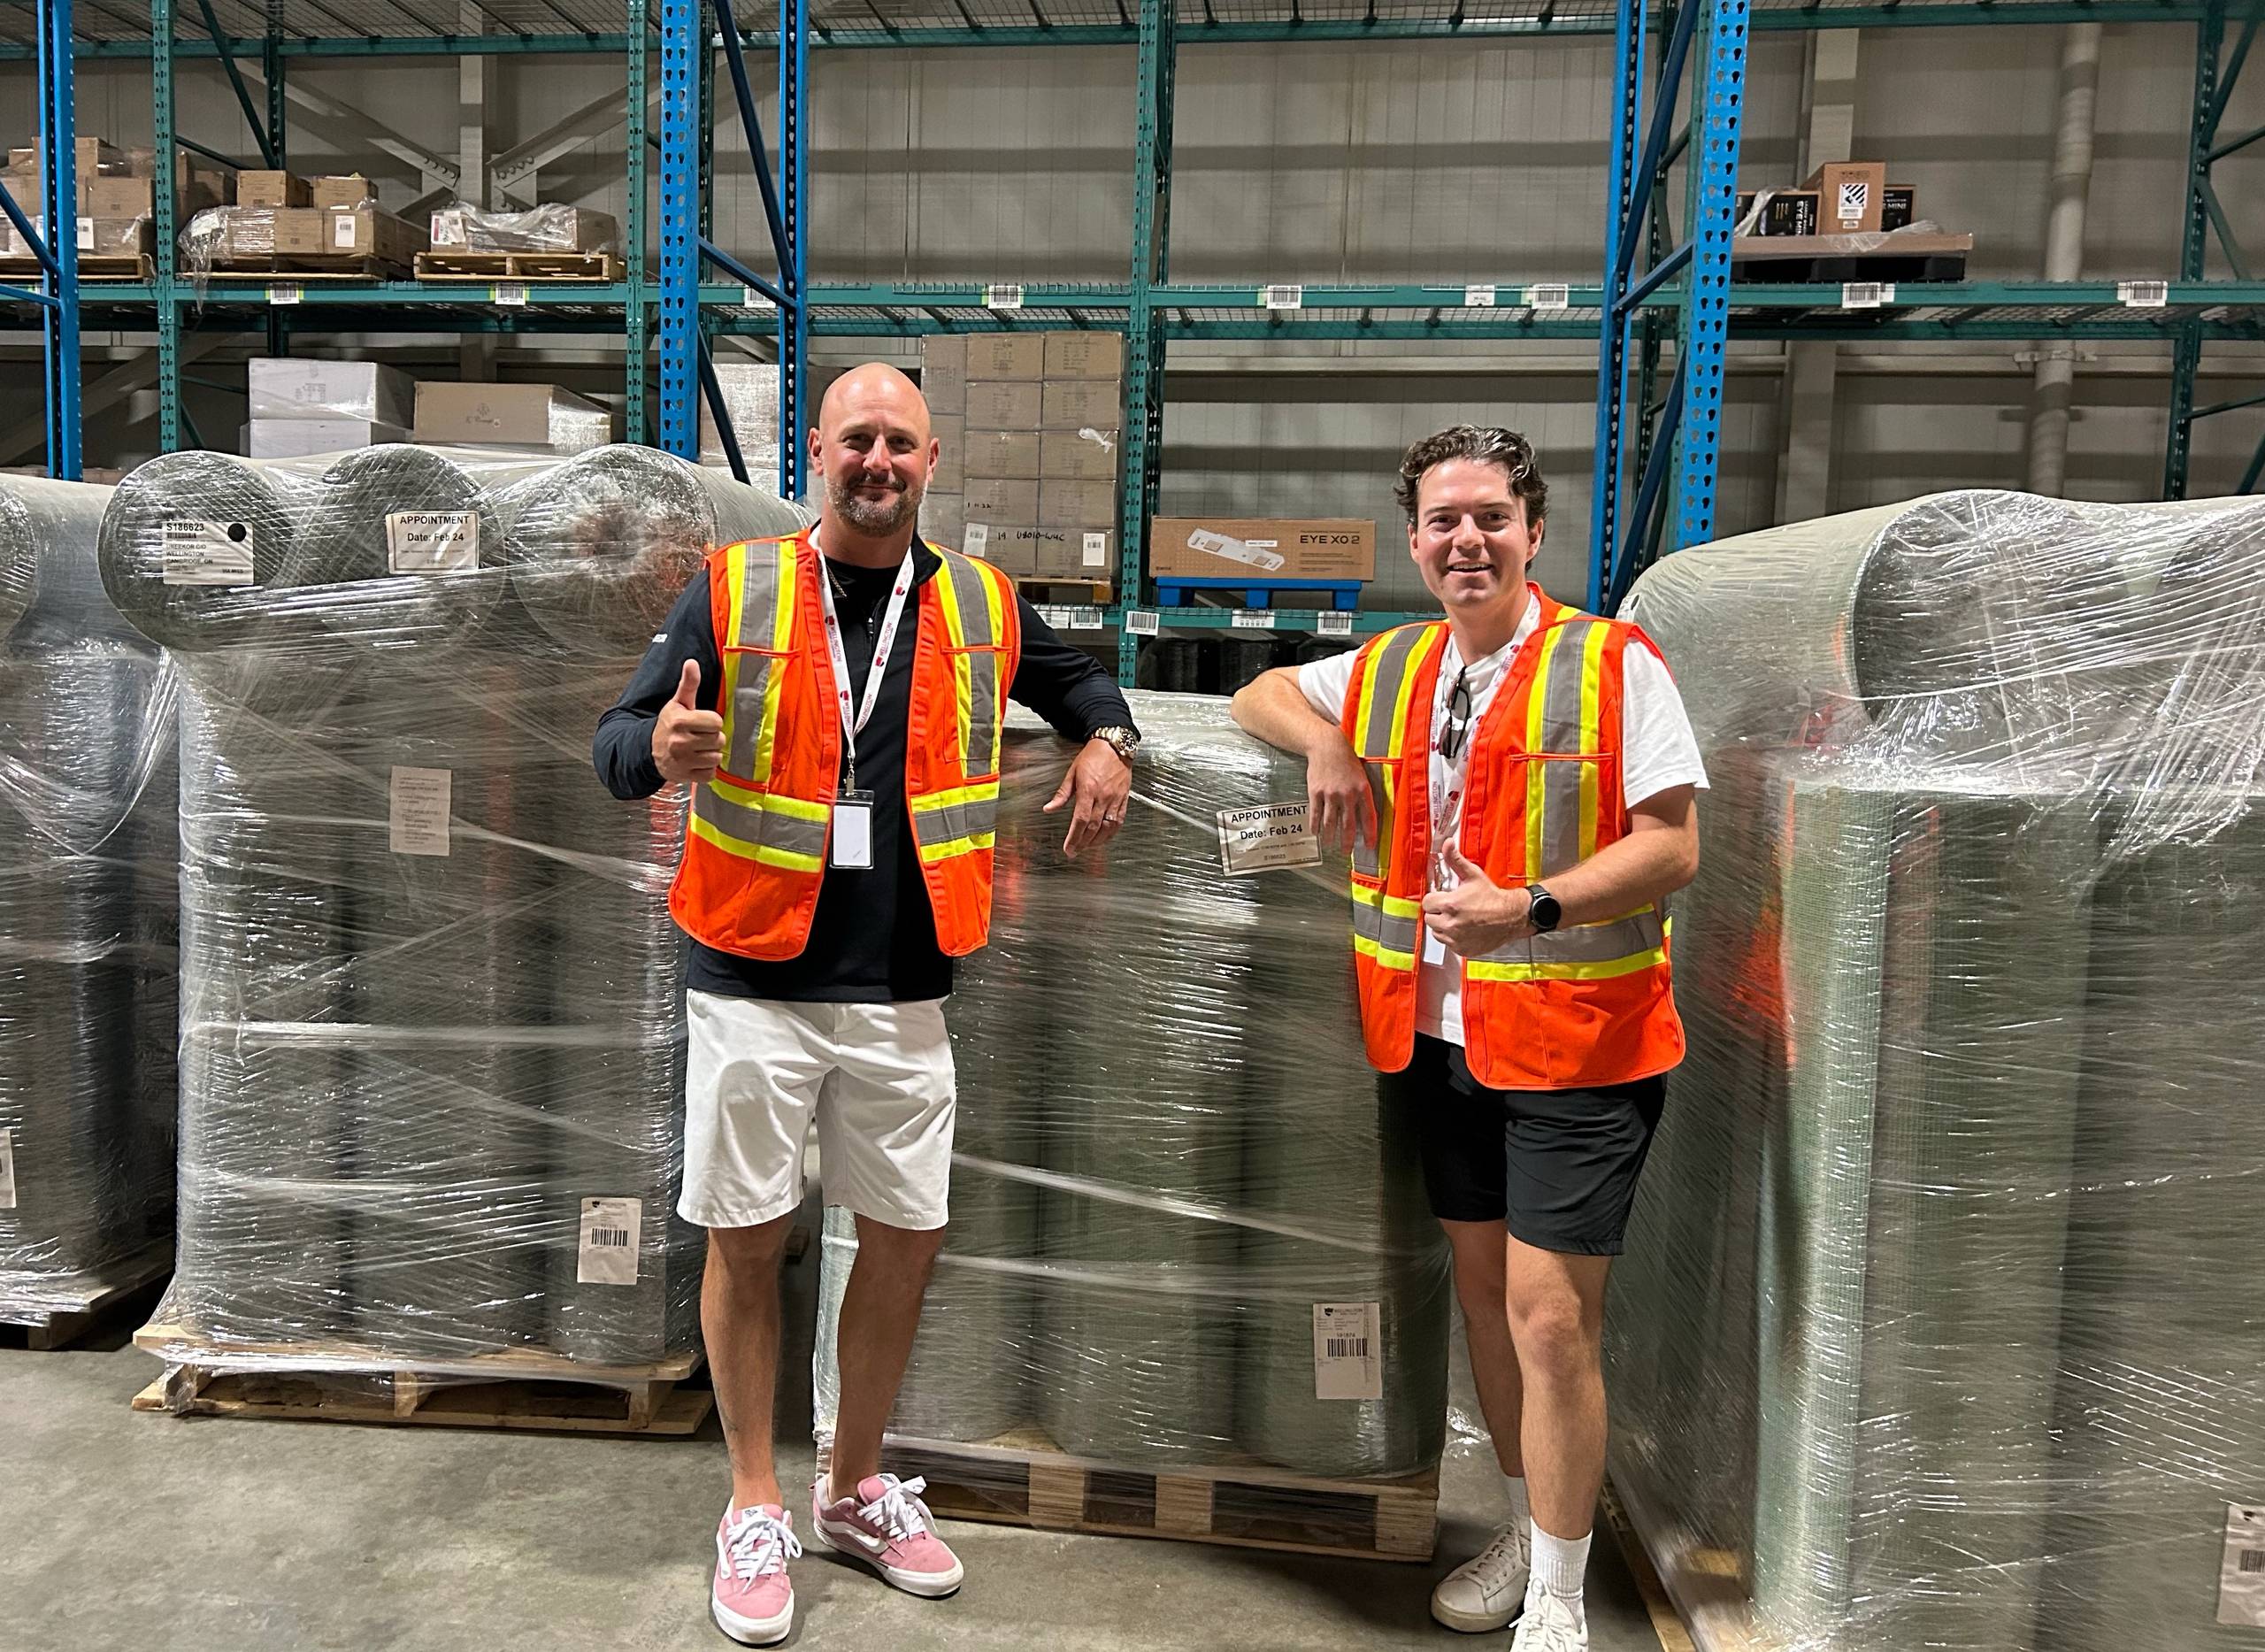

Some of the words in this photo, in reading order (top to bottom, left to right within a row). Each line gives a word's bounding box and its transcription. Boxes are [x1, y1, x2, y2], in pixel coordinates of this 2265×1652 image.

[166, 522, 204, 532] S186623
[400, 516, 469, 525] APPOINTMENT
[407, 533, 431, 542] Date:
[434, 533, 450, 542] Feb
[452, 533, 465, 542] 24
[1300, 534, 1328, 544] EYE
[1331, 535, 1349, 544] XO
[1351, 535, 1360, 544] 2
[829, 624, 842, 662] WELLINGTON
[879, 621, 893, 657] WELLINGTON
[1231, 805, 1308, 824] APPOINTMENT
[1240, 829, 1267, 840] Date:
[1270, 826, 1288, 836] Feb
[1291, 824, 1303, 834] 24
